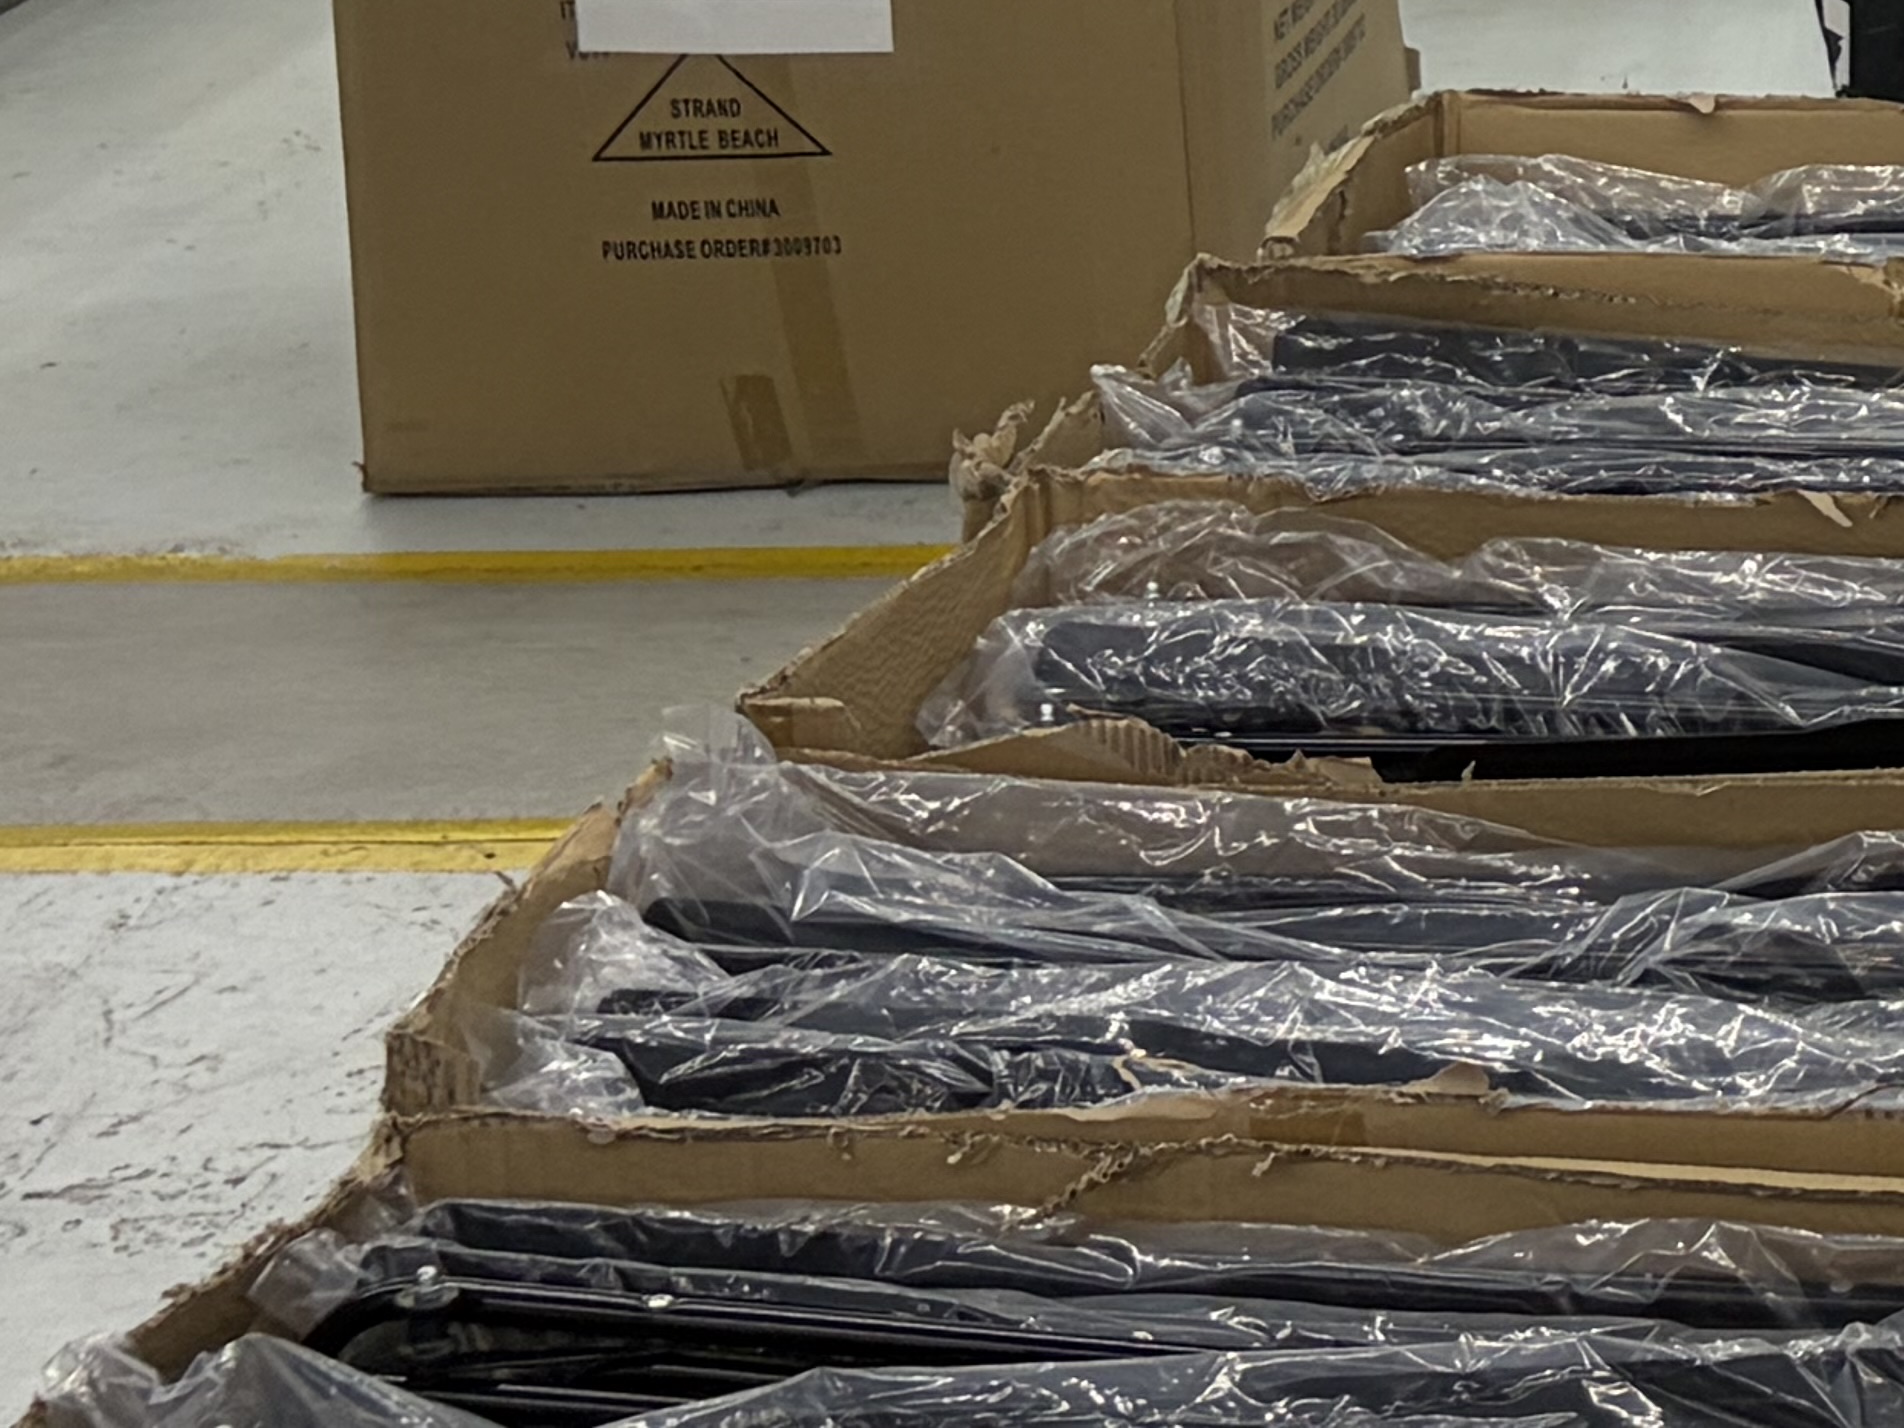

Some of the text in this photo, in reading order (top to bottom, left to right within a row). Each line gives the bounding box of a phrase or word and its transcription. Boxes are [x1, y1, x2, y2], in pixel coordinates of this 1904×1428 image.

[669, 97, 742, 120] STRAND
[638, 127, 780, 152] MYRTLE BEACH
[651, 197, 781, 221] MADE IN CHINA
[601, 239, 697, 262] PURCHASE
